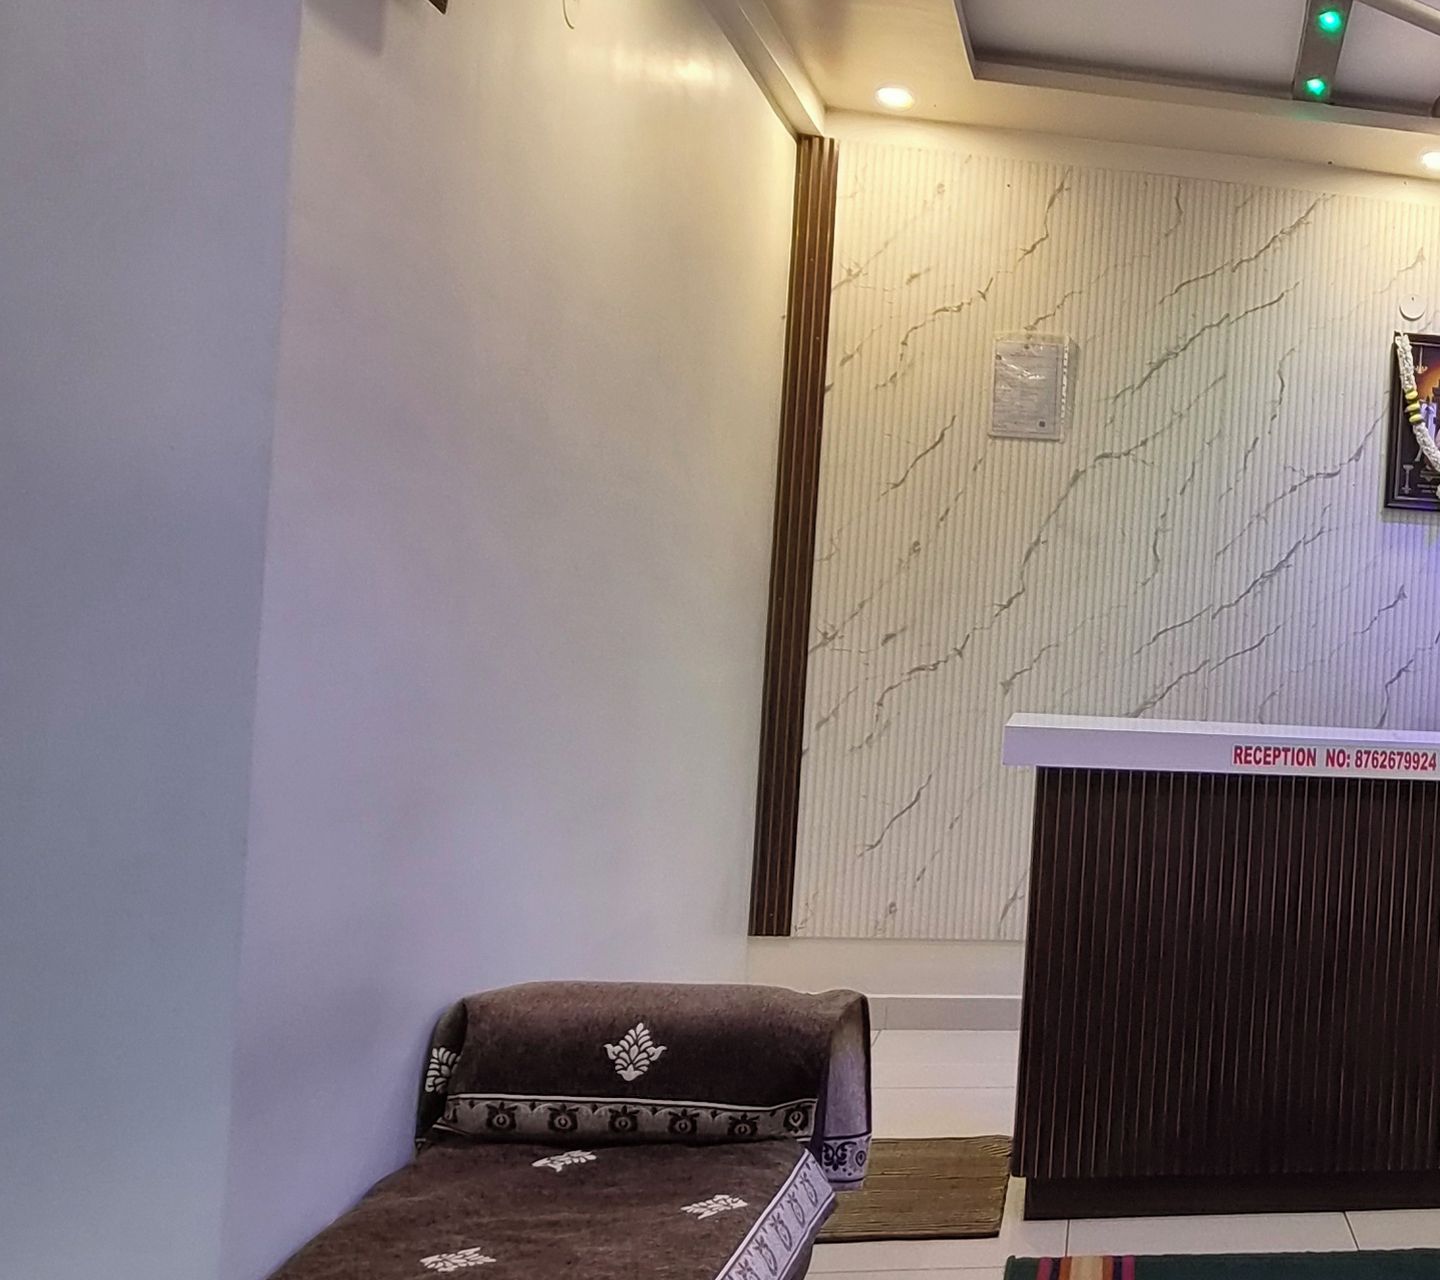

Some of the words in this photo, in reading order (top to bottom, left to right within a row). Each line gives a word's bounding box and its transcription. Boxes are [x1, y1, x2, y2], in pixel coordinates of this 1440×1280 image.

[1233, 744, 1317, 767] RECEPTION
[1325, 748, 1350, 768] NO:
[1354, 749, 1437, 771] 8762679924
